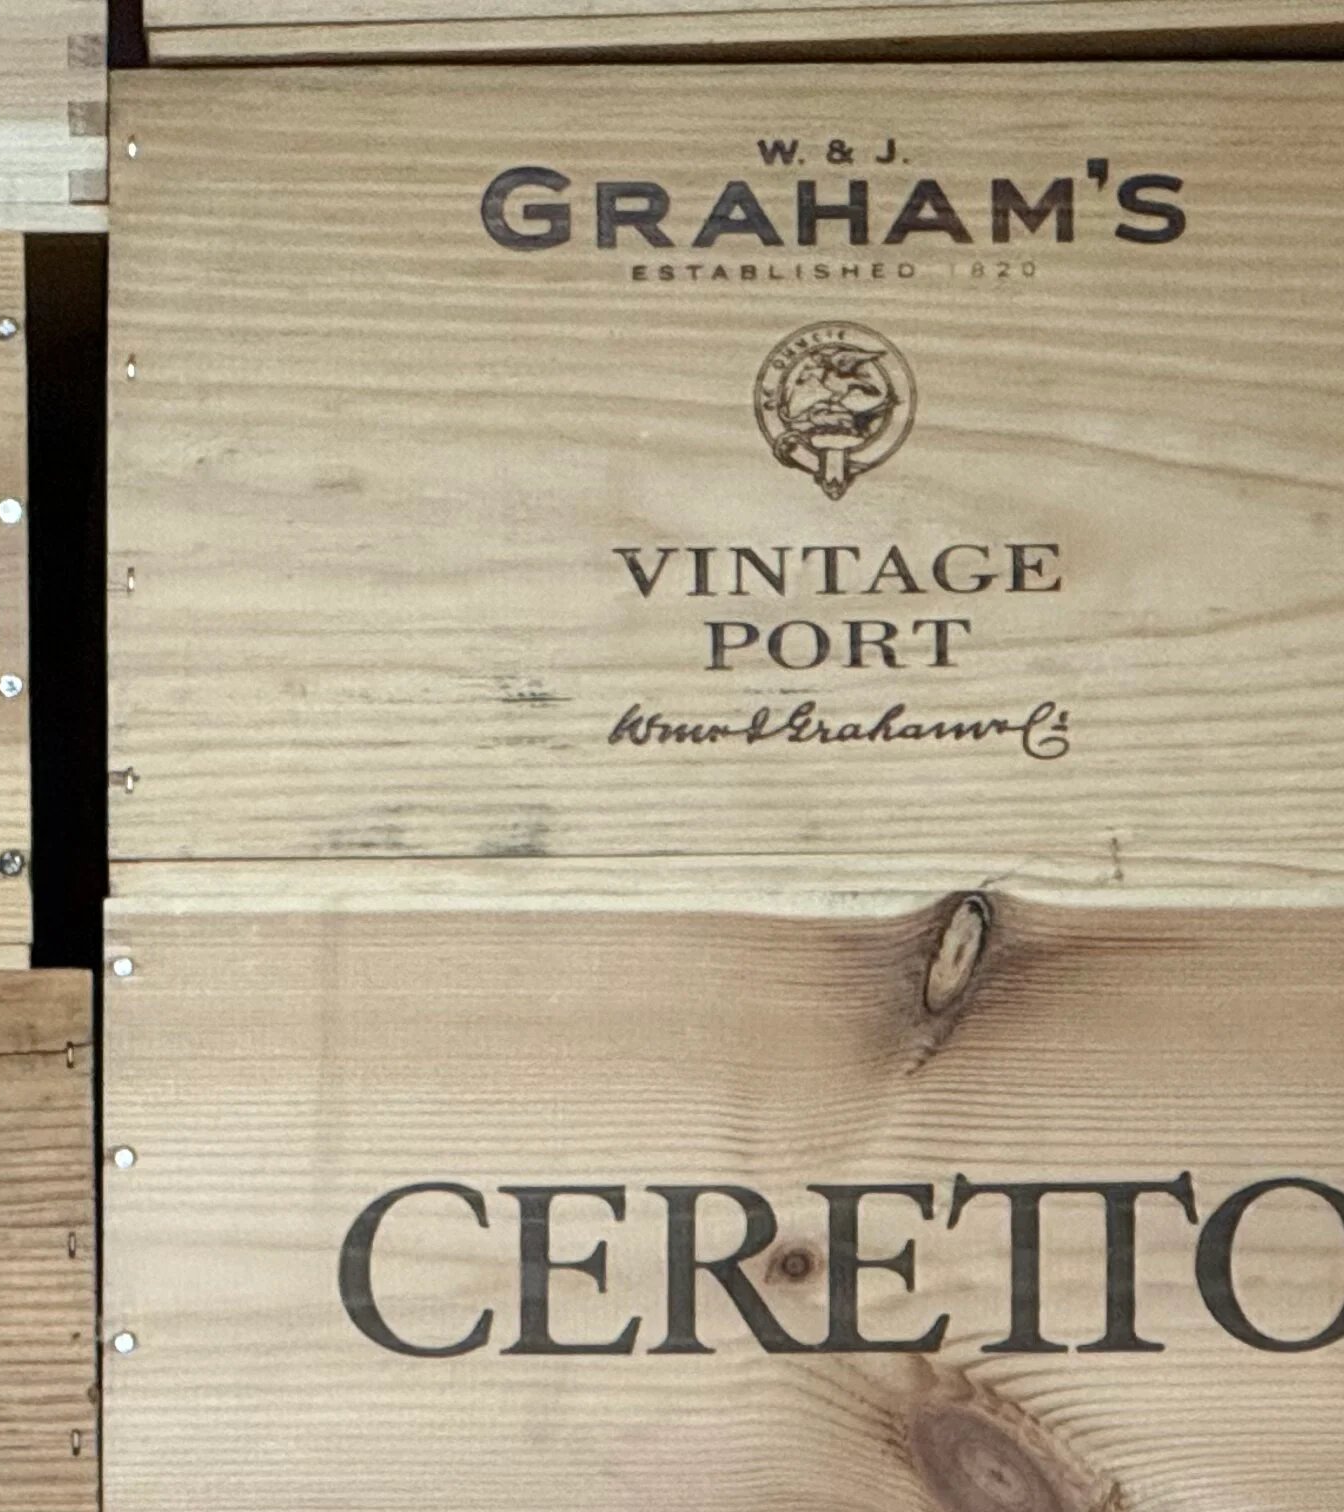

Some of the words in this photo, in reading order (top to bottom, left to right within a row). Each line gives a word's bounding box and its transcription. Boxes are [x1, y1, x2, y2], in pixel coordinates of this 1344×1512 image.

[757, 138, 805, 166] W.
[825, 138, 854, 165] &
[875, 137, 910, 165] J.
[479, 157, 1188, 252] GRAHAM'S
[631, 263, 916, 282] ESTABLISHED
[611, 542, 1064, 599] VINTAGE
[702, 618, 973, 671] PORT
